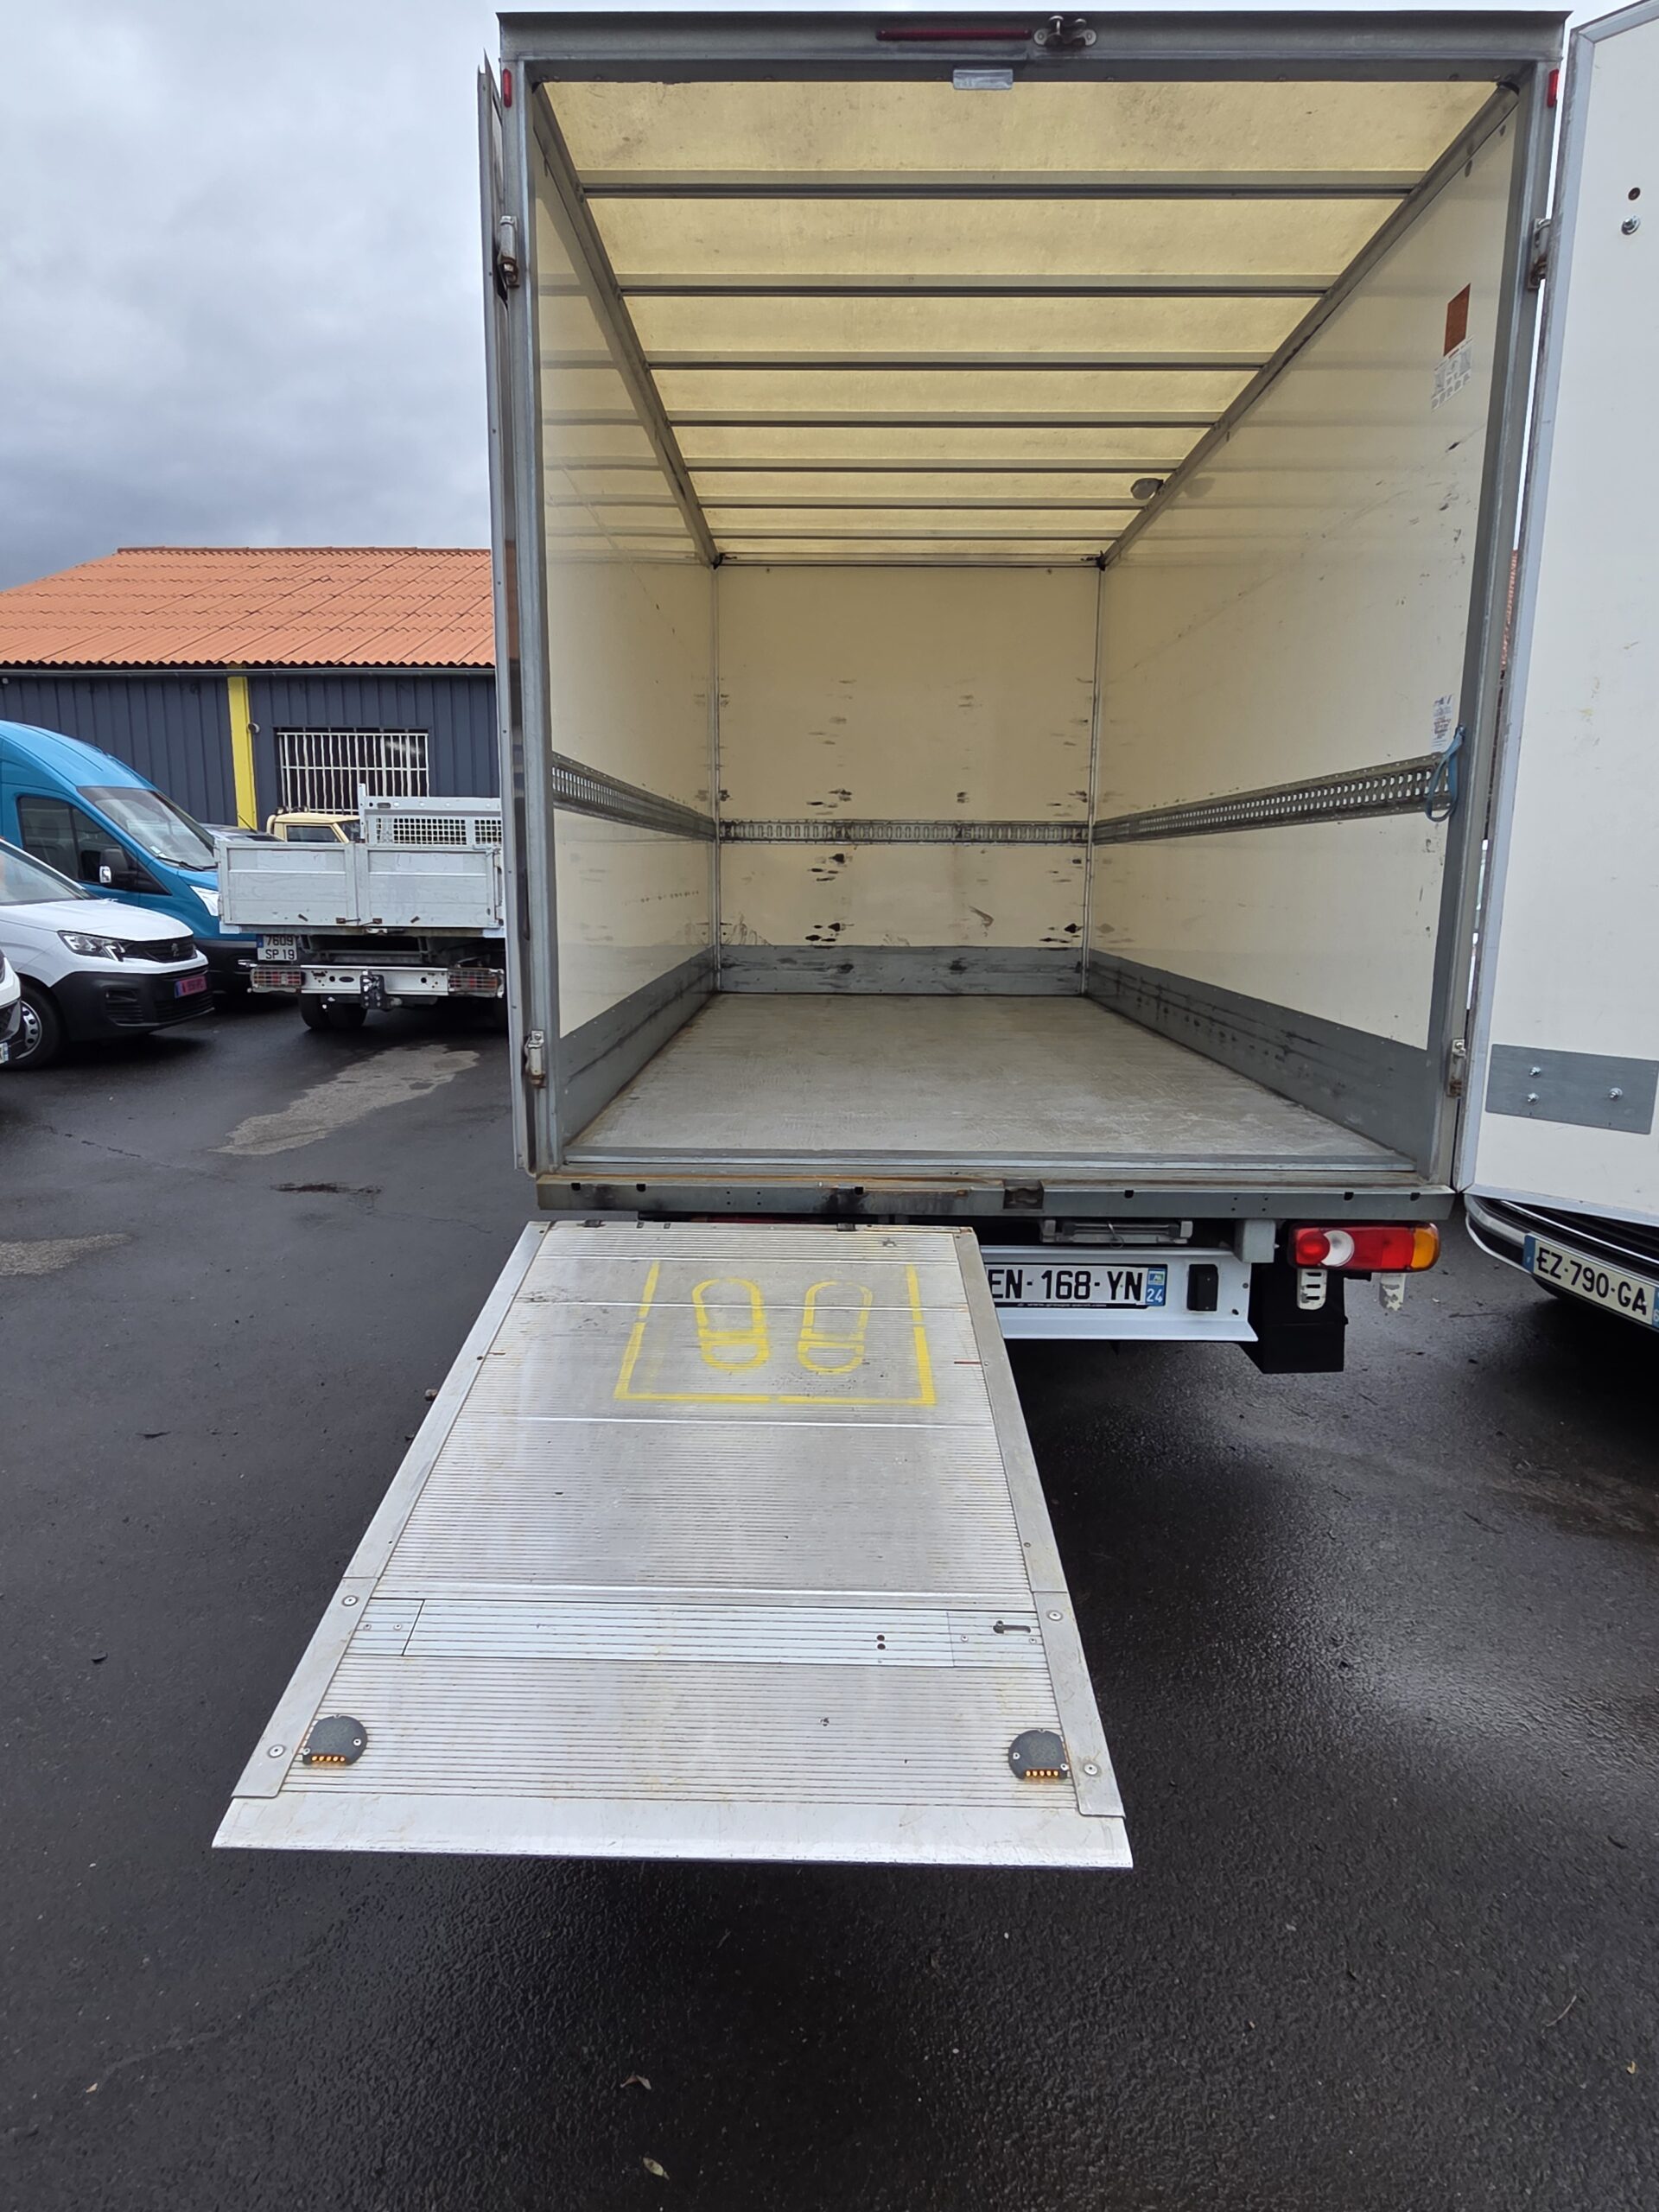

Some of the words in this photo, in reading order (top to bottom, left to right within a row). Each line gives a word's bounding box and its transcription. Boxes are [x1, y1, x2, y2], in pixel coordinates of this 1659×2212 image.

[266, 935, 294, 946] 7609
[265, 949, 279, 959] SP
[283, 949, 295, 959] 19
[1536, 1247, 1647, 1315] EZ-790-GA
[1146, 1287, 1163, 1302] 24
